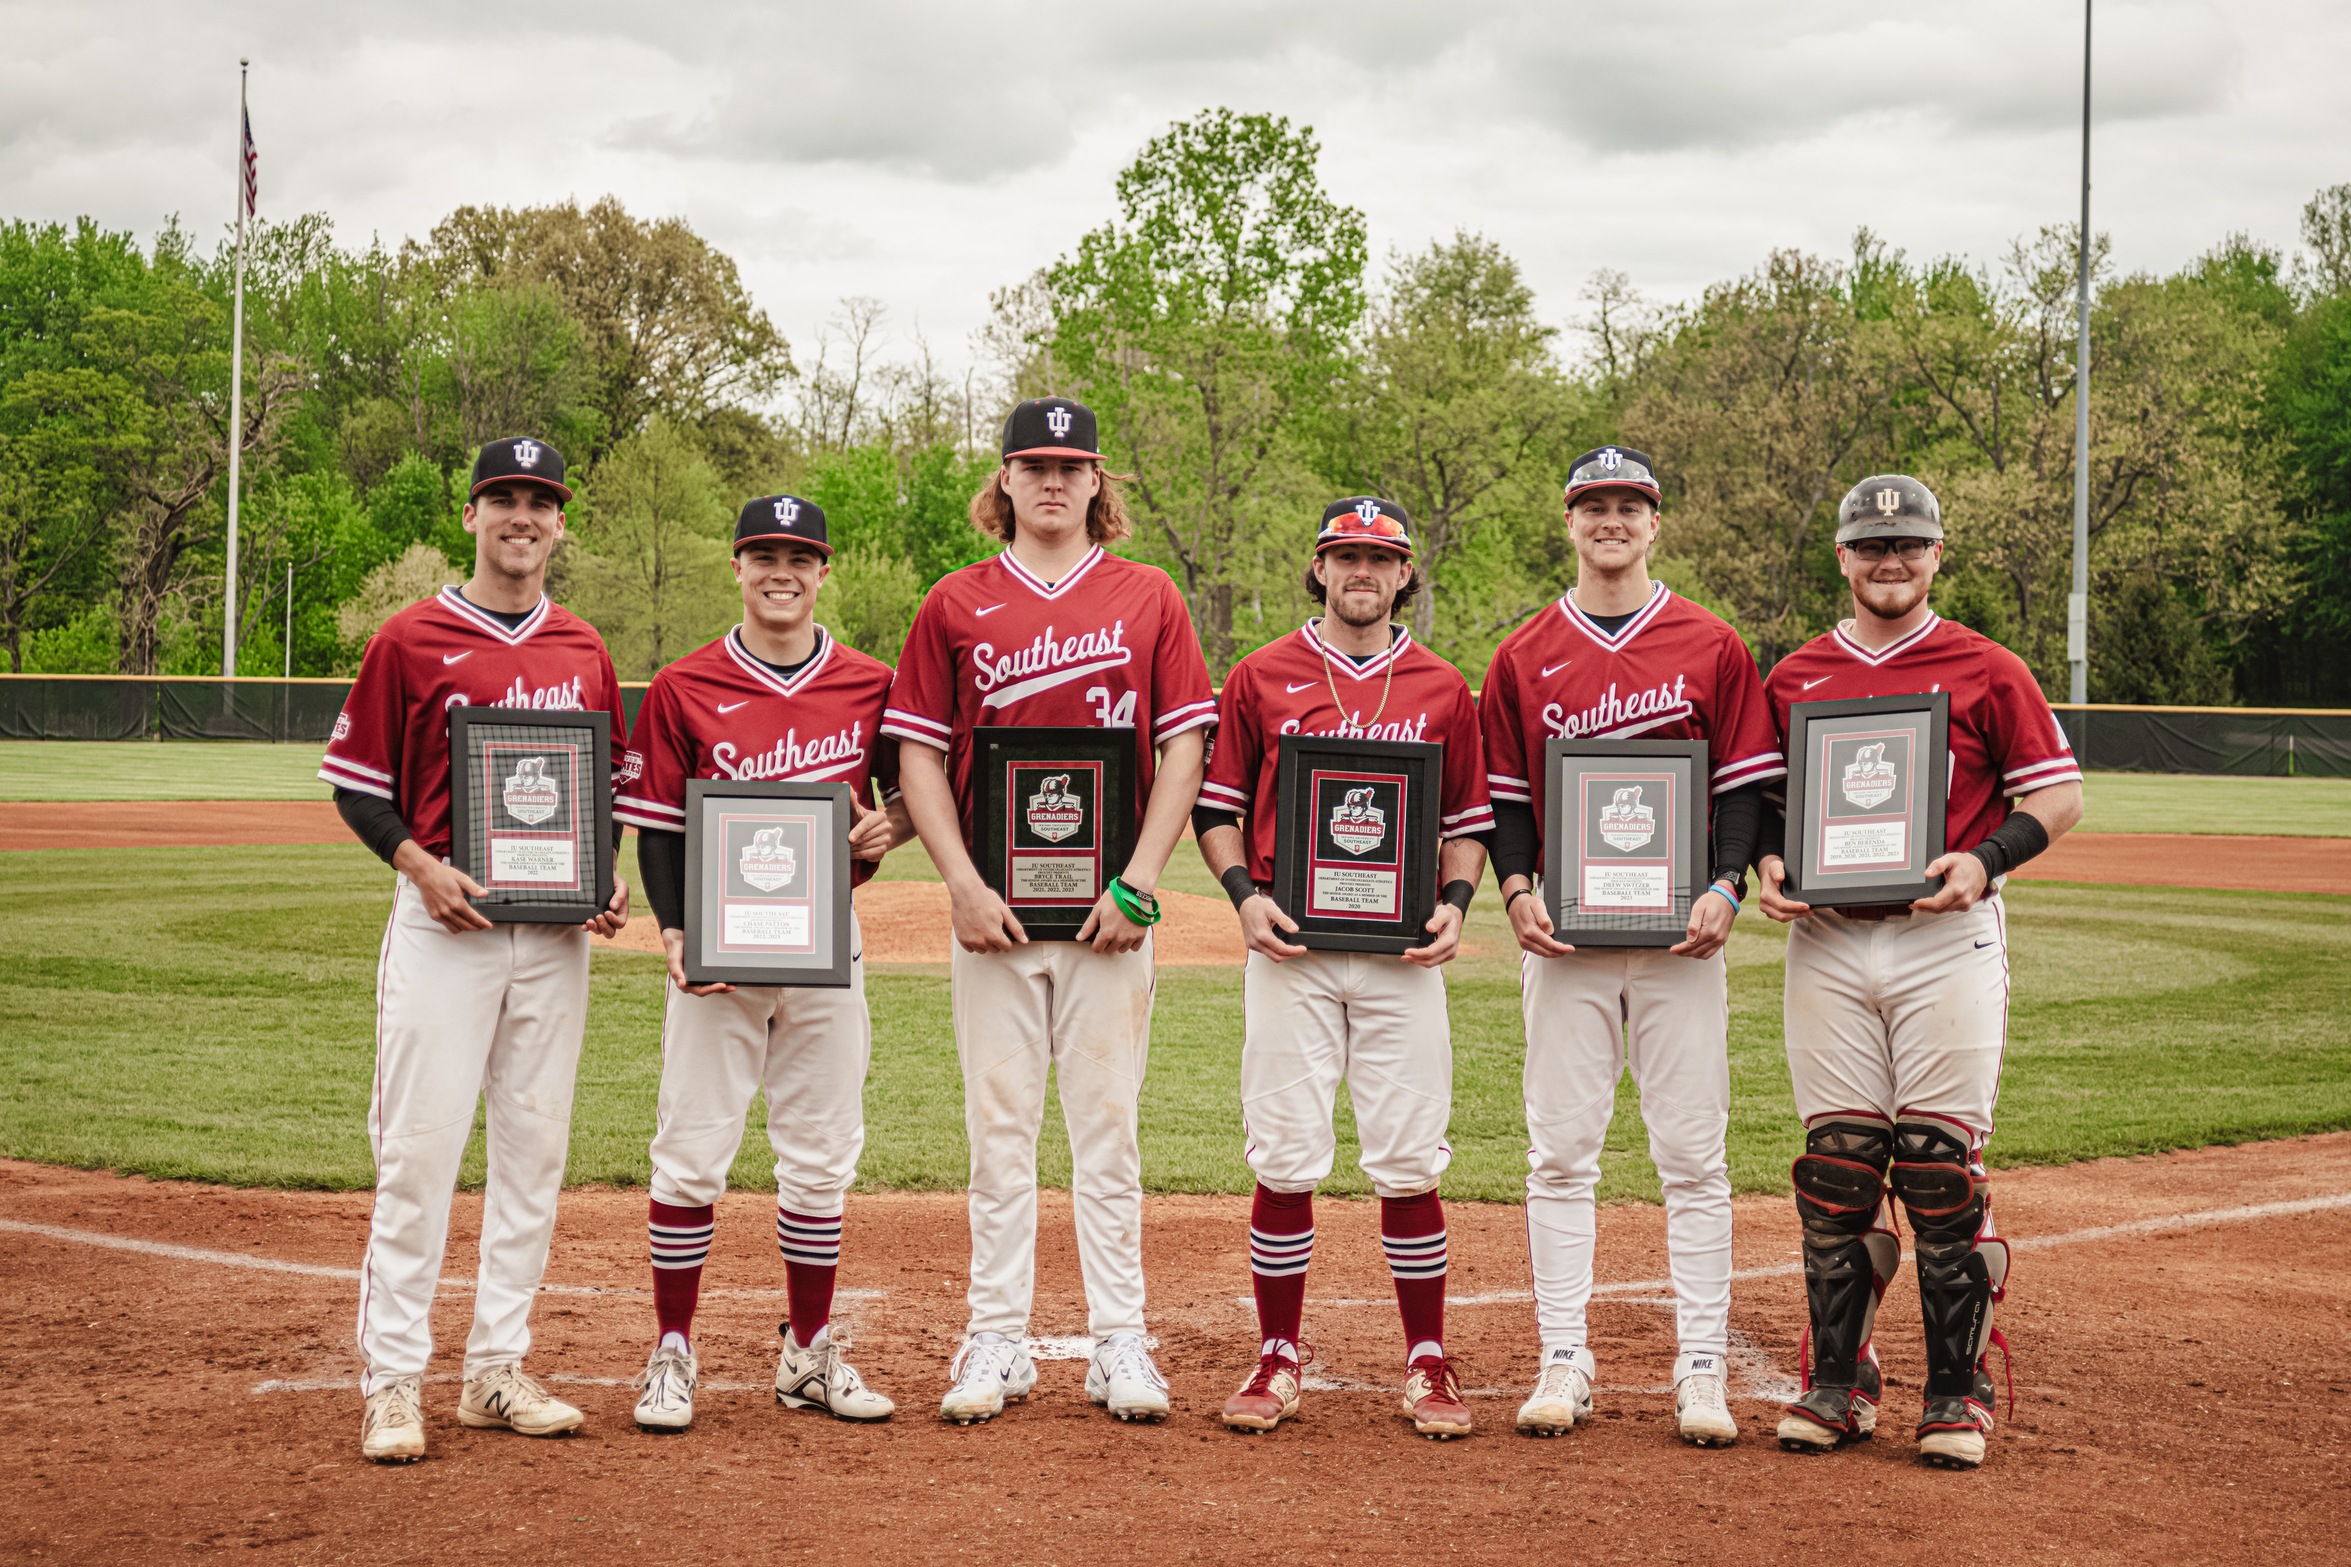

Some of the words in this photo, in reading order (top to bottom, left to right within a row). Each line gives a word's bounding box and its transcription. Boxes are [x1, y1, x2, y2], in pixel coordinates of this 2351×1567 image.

[973, 620, 1126, 691] Southeast
[1086, 687, 1137, 727] 34
[1542, 674, 1686, 738] Southeast
[711, 720, 862, 781] Southeast
[1847, 780, 1892, 788] GRENADIERS
[1335, 825, 1381, 834] GRENADIERS
[1552, 1349, 1576, 1360] NIKE
[1691, 1359, 1714, 1369] NIKE
